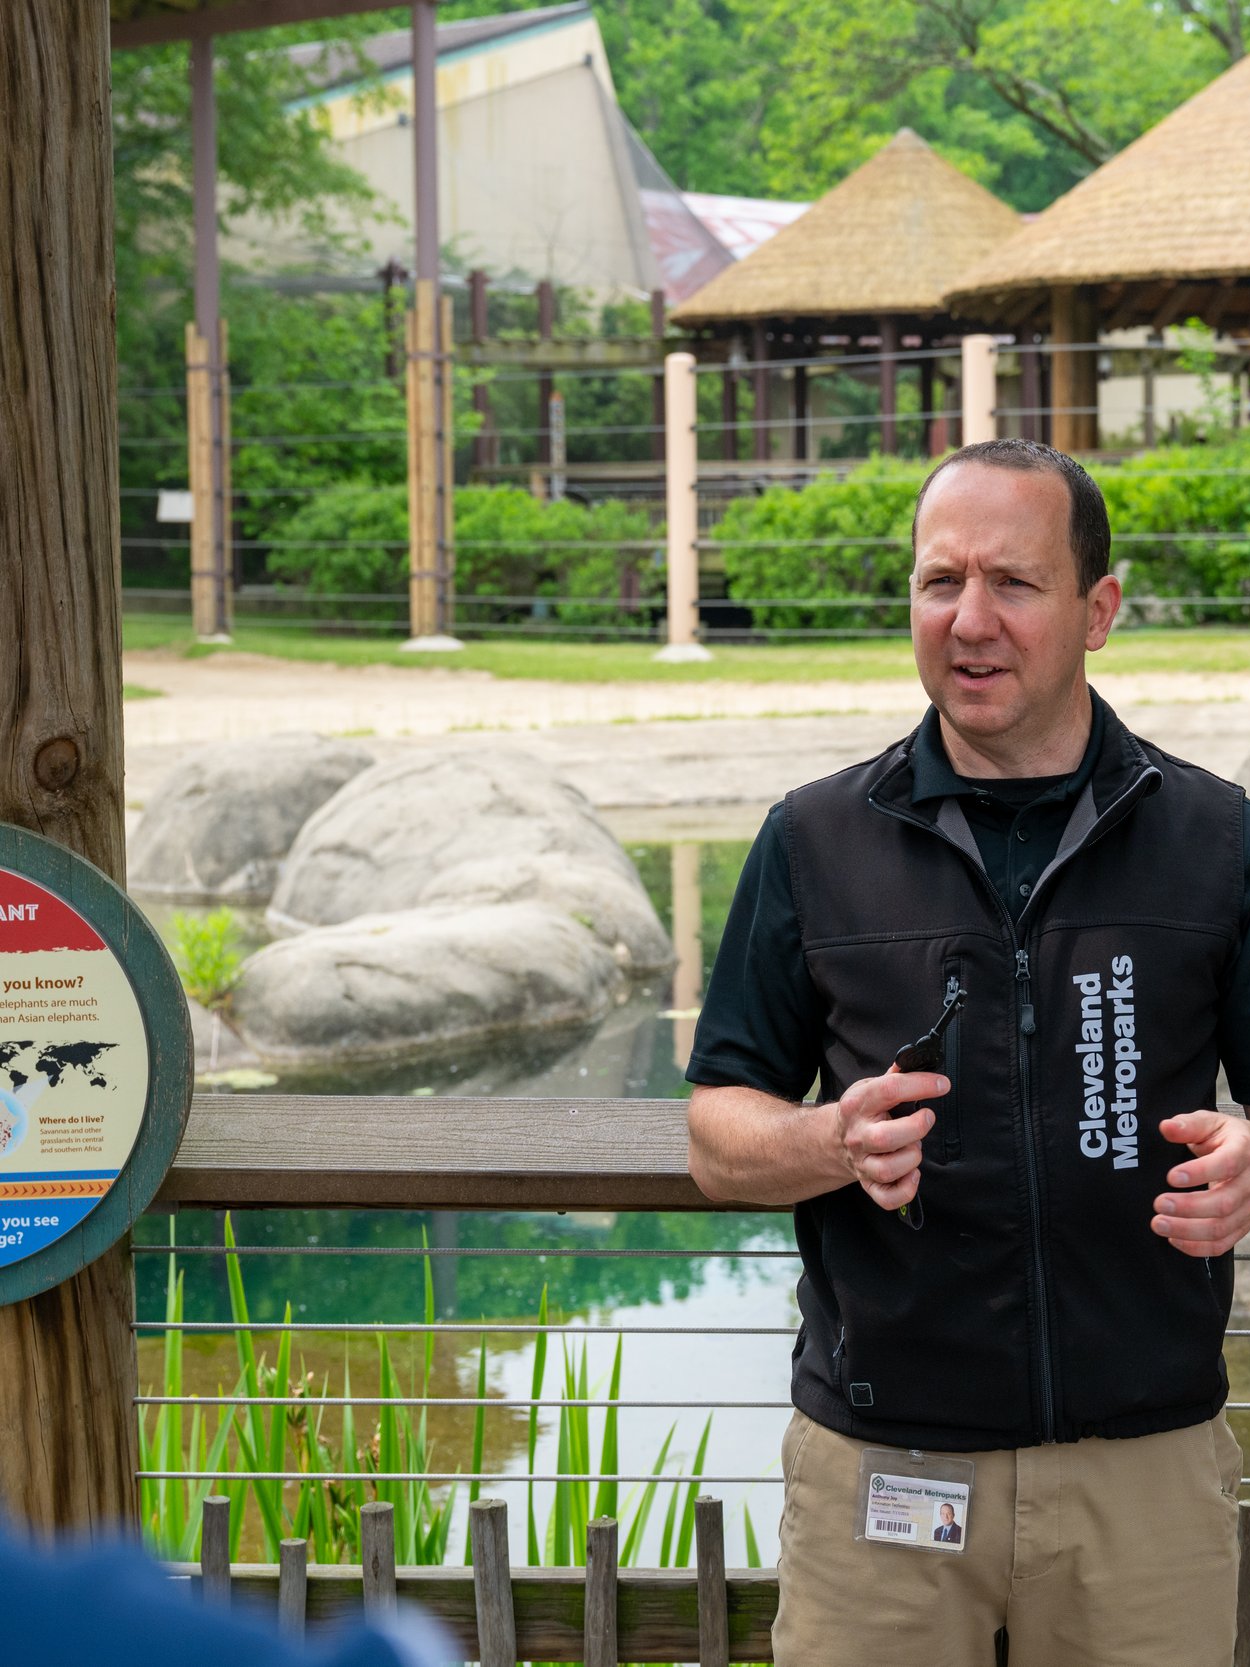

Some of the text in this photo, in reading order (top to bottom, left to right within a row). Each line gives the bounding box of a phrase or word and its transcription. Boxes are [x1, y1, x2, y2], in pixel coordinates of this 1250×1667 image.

[3, 976, 84, 993] you know?
[0, 997, 98, 1010] elephants are much
[18, 1013, 45, 1023] Asian
[47, 1012, 100, 1024] elephants.
[1072, 972, 1108, 1159] Cleveland
[1106, 955, 1142, 1170] Metroparks
[39, 1116, 66, 1125] Where
[68, 1116, 79, 1124] do
[85, 1115, 104, 1123] live?
[40, 1137, 73, 1146] grasslands
[1, 1216, 59, 1231] you see
[886, 1485, 967, 1501] Cleveland Metroparks
